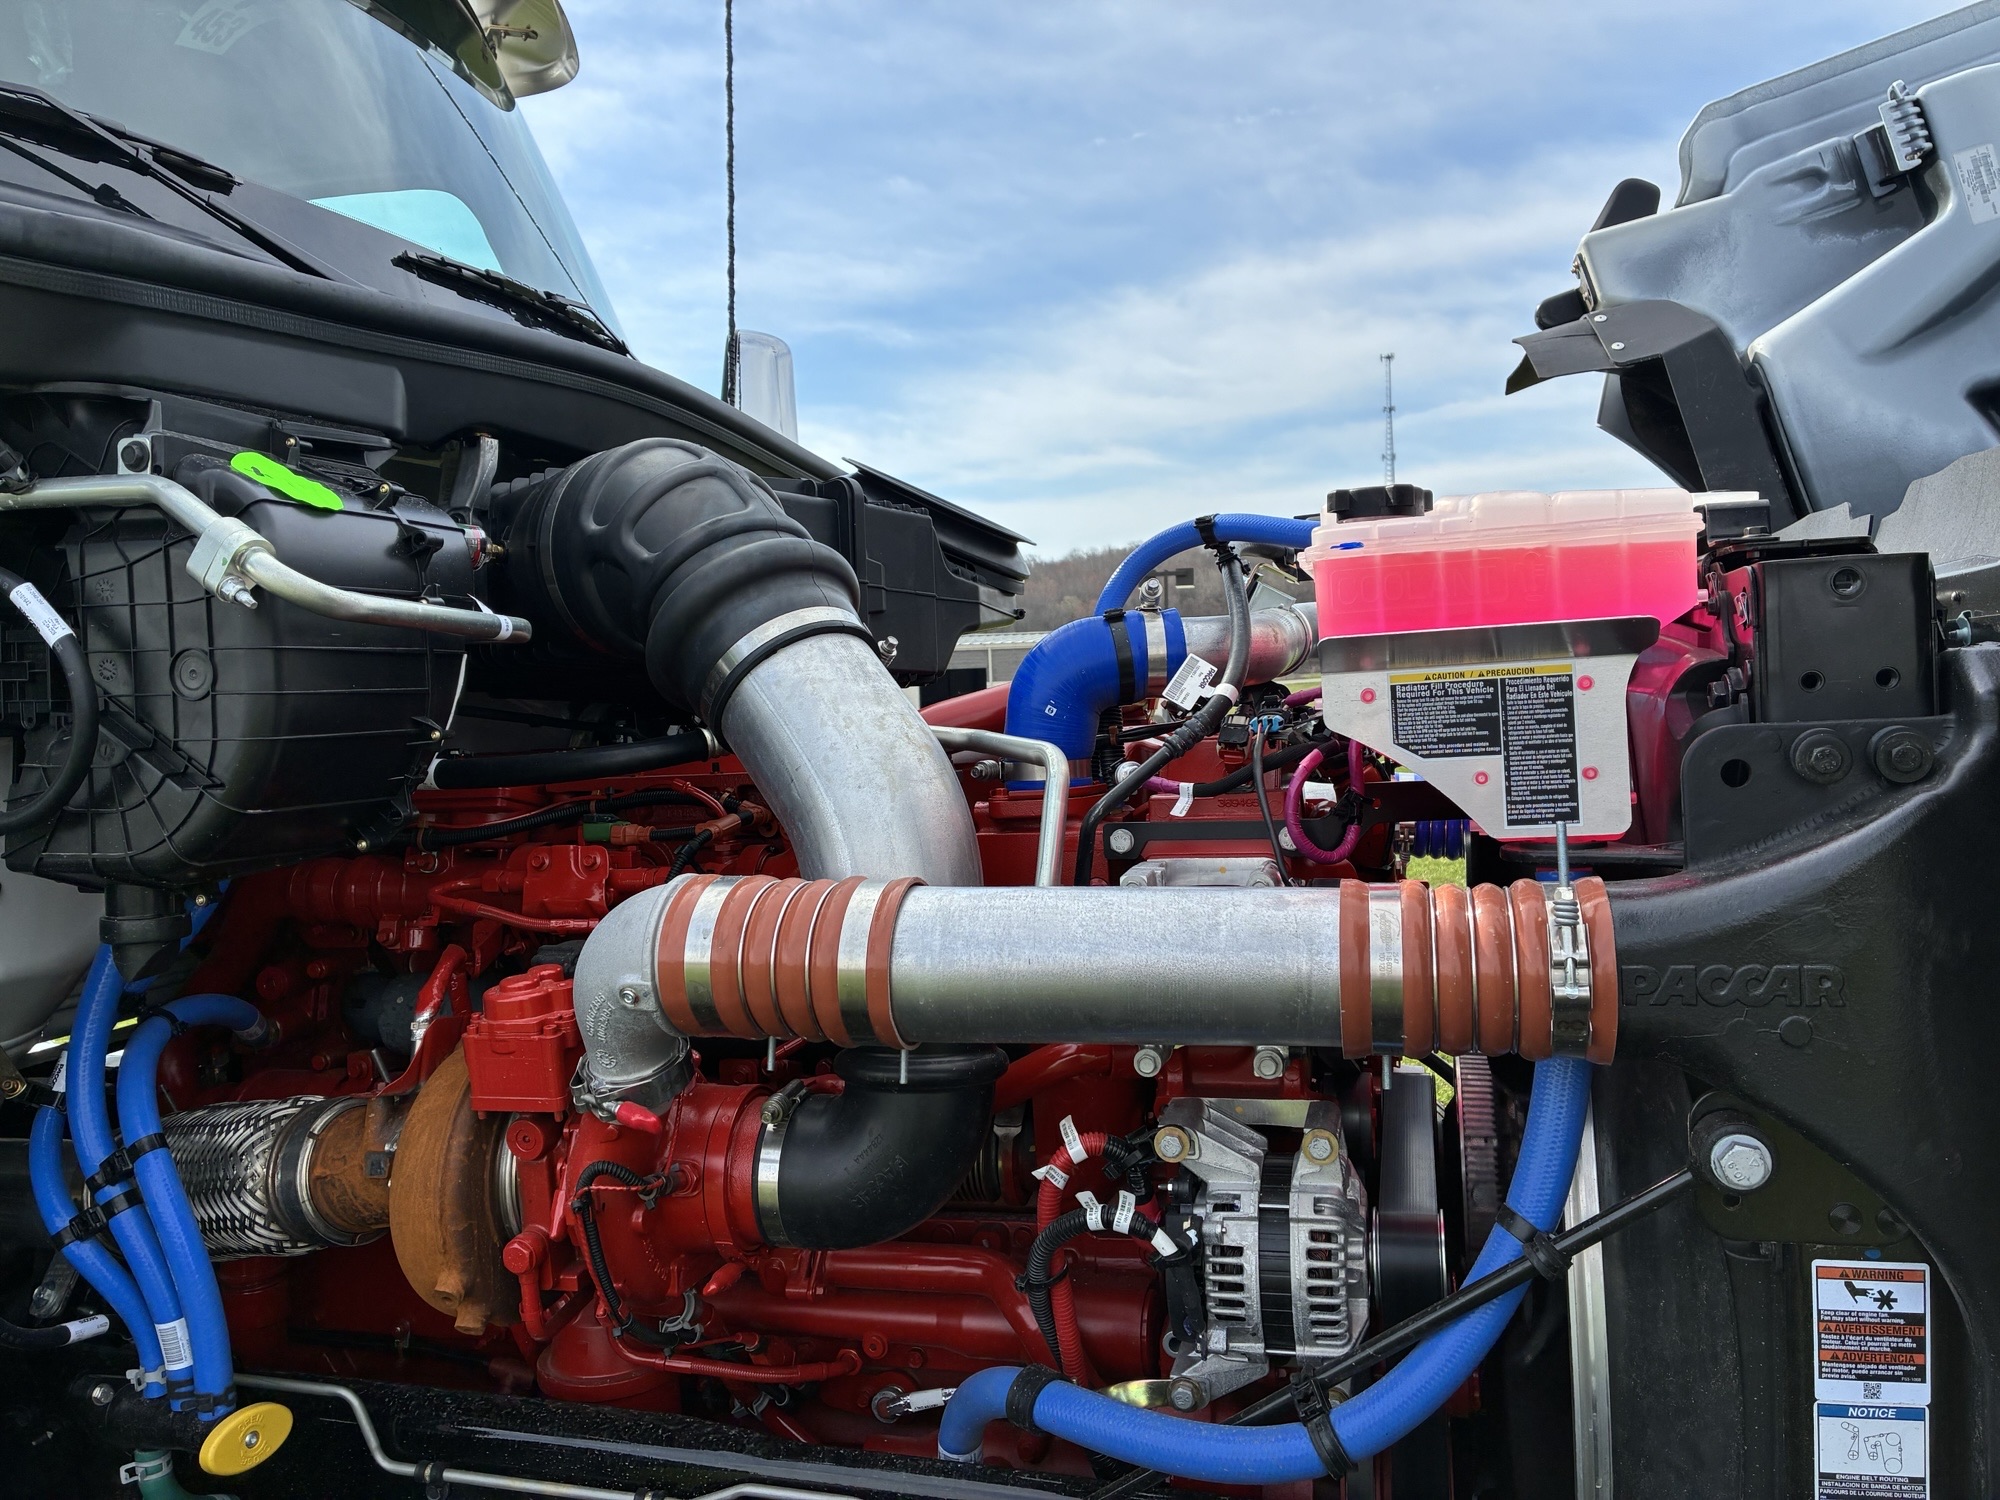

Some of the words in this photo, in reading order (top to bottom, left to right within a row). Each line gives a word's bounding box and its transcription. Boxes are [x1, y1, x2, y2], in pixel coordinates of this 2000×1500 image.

[1199, 668, 1215, 689] PACCAR
[1432, 672, 1465, 680] CAUTION
[1486, 667, 1535, 677] PRECAUCION
[1397, 690, 1430, 698] Required
[1621, 964, 1846, 1007] PACCAR
[1852, 1270, 1904, 1280] WARNING
[1834, 1324, 1923, 1335] AVERTISSEMENT
[1842, 1352, 1915, 1363] ADVERTENCIA
[1848, 1408, 1897, 1418] NOTICE
